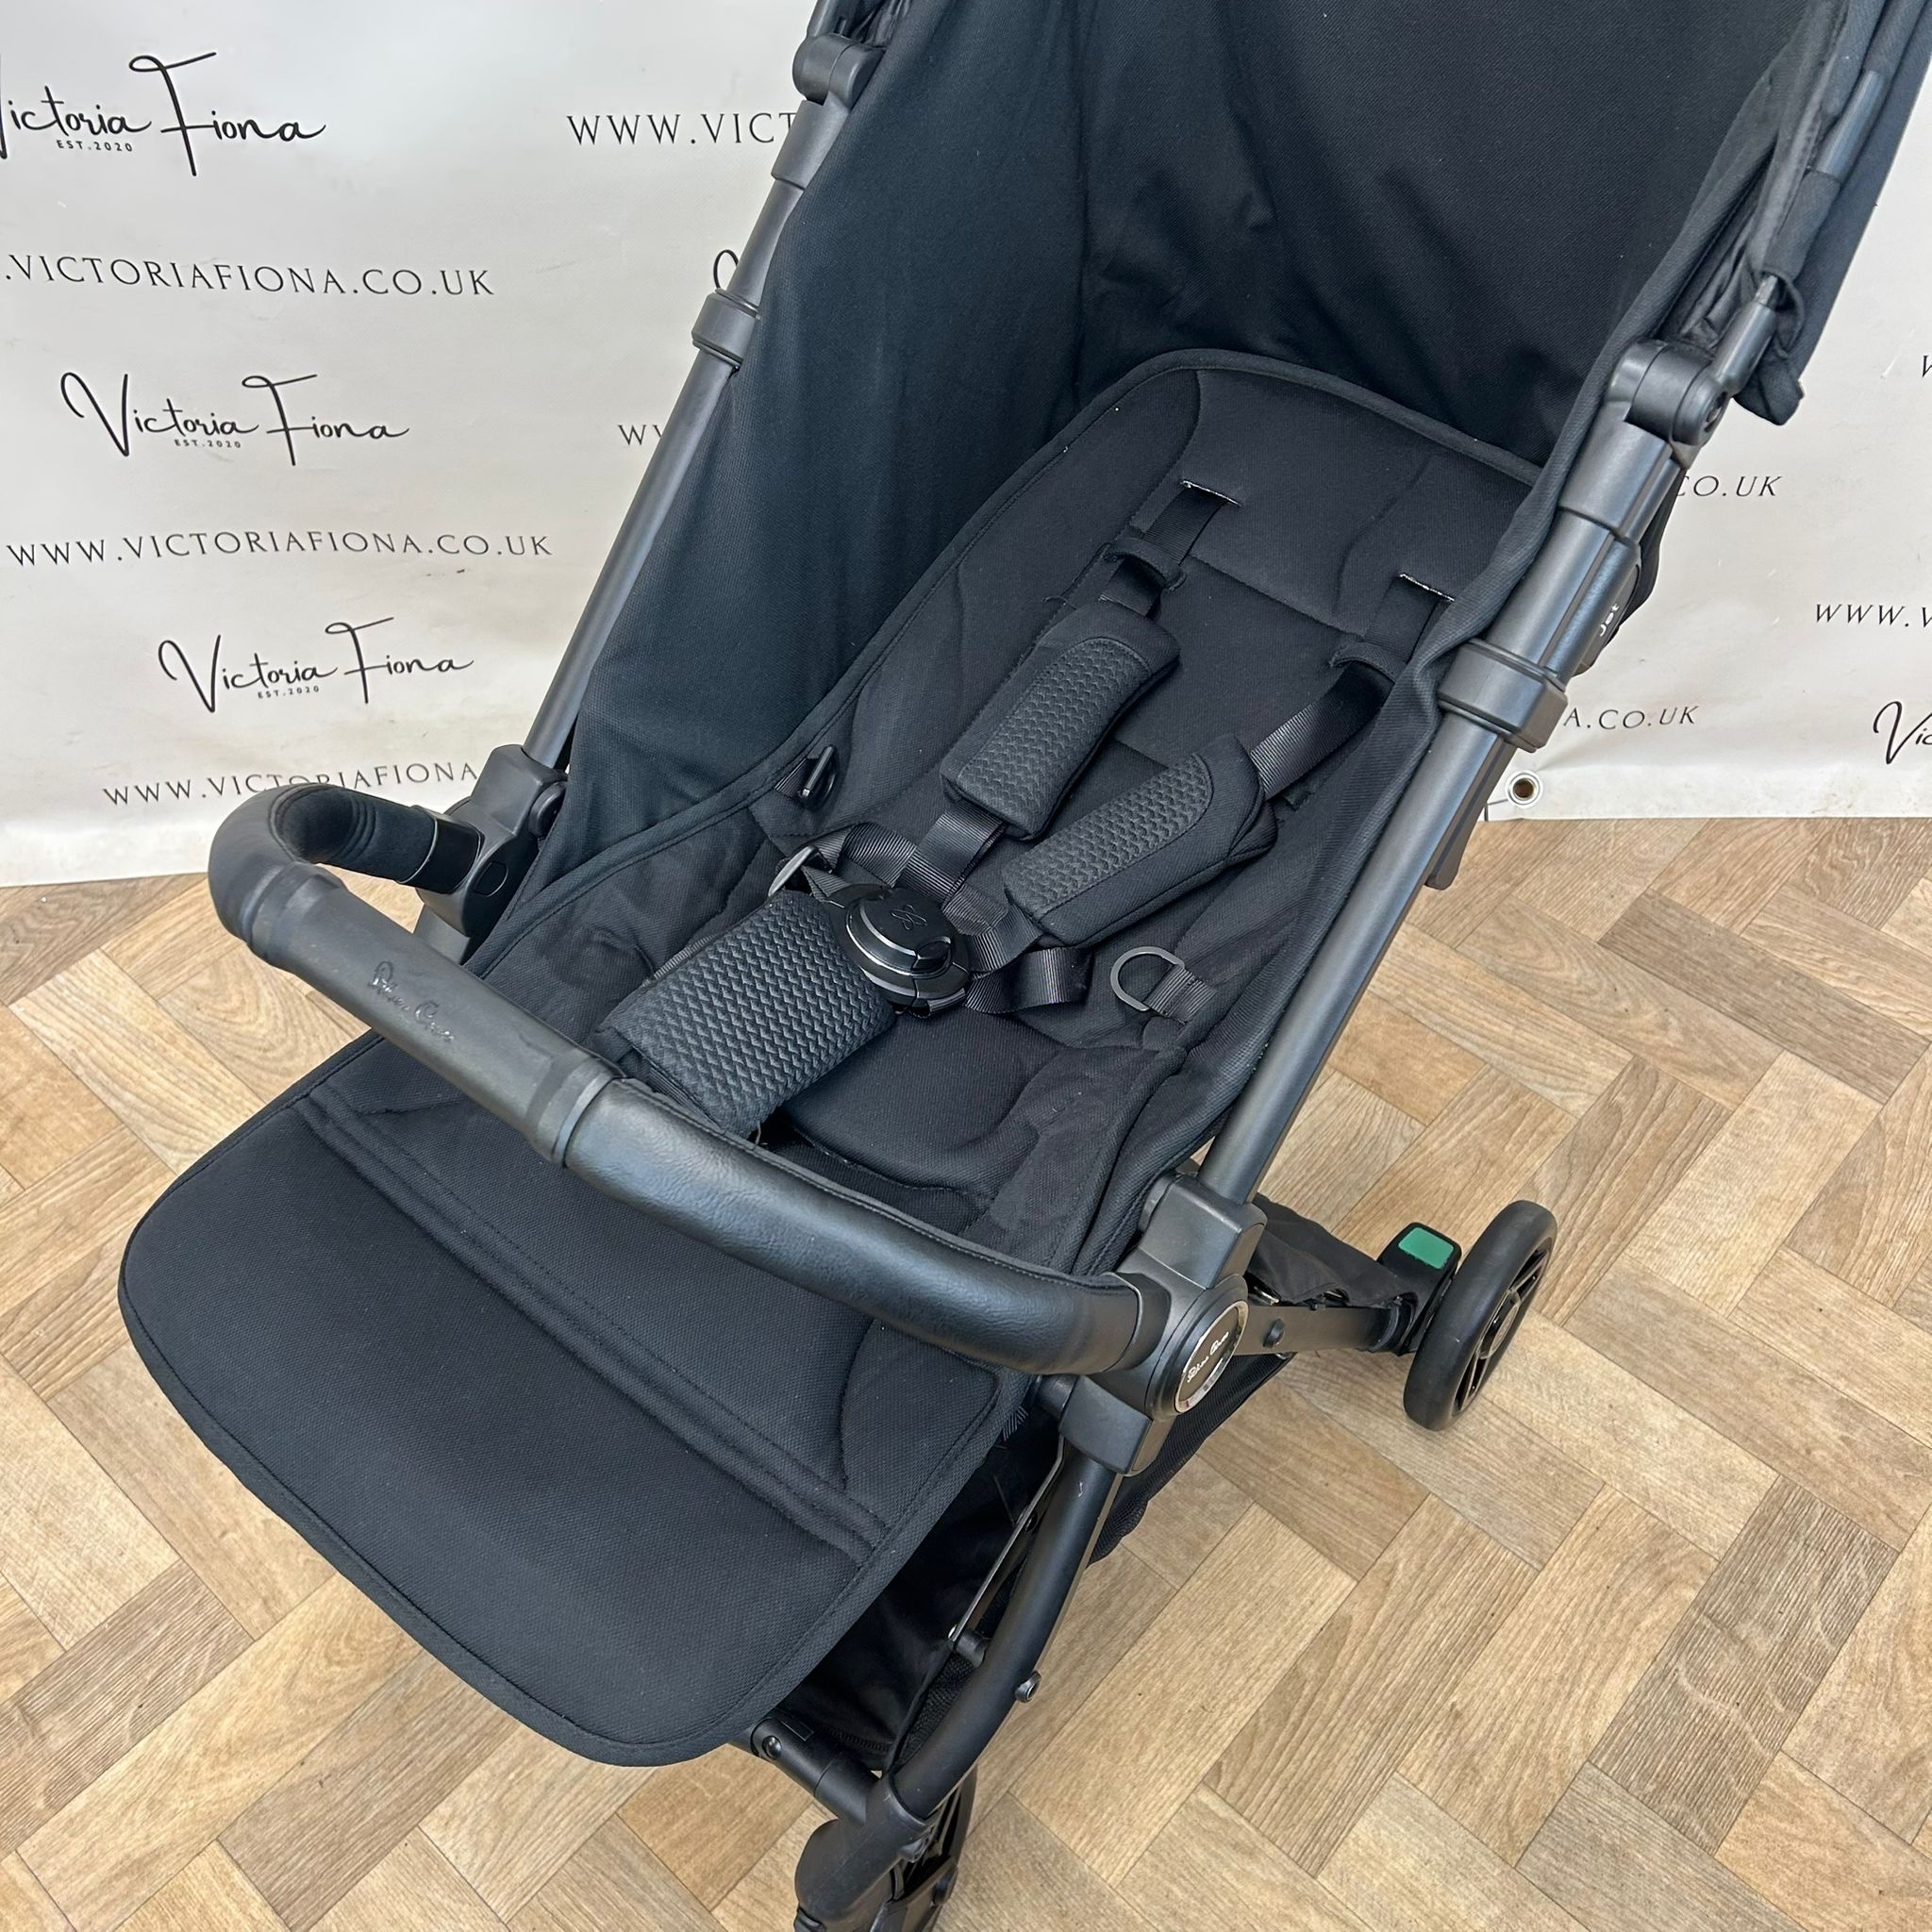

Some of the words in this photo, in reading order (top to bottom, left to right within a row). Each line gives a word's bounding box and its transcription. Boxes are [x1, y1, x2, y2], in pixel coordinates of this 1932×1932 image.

[0, 81, 152, 158] ictoria
[128, 52, 327, 176] Fiona
[56, 139, 133, 152] EST.2020
[59, 372, 259, 457] Victoria
[241, 374, 410, 466] Fiona
[174, 438, 242, 450] EST.2020
[6, 530, 553, 567] WWW.VICTORIAFIONA.CO.UK
[158, 634, 339, 714] Victoria
[325, 616, 475, 705] Fiona
[257, 685, 320, 699] EST.2020
